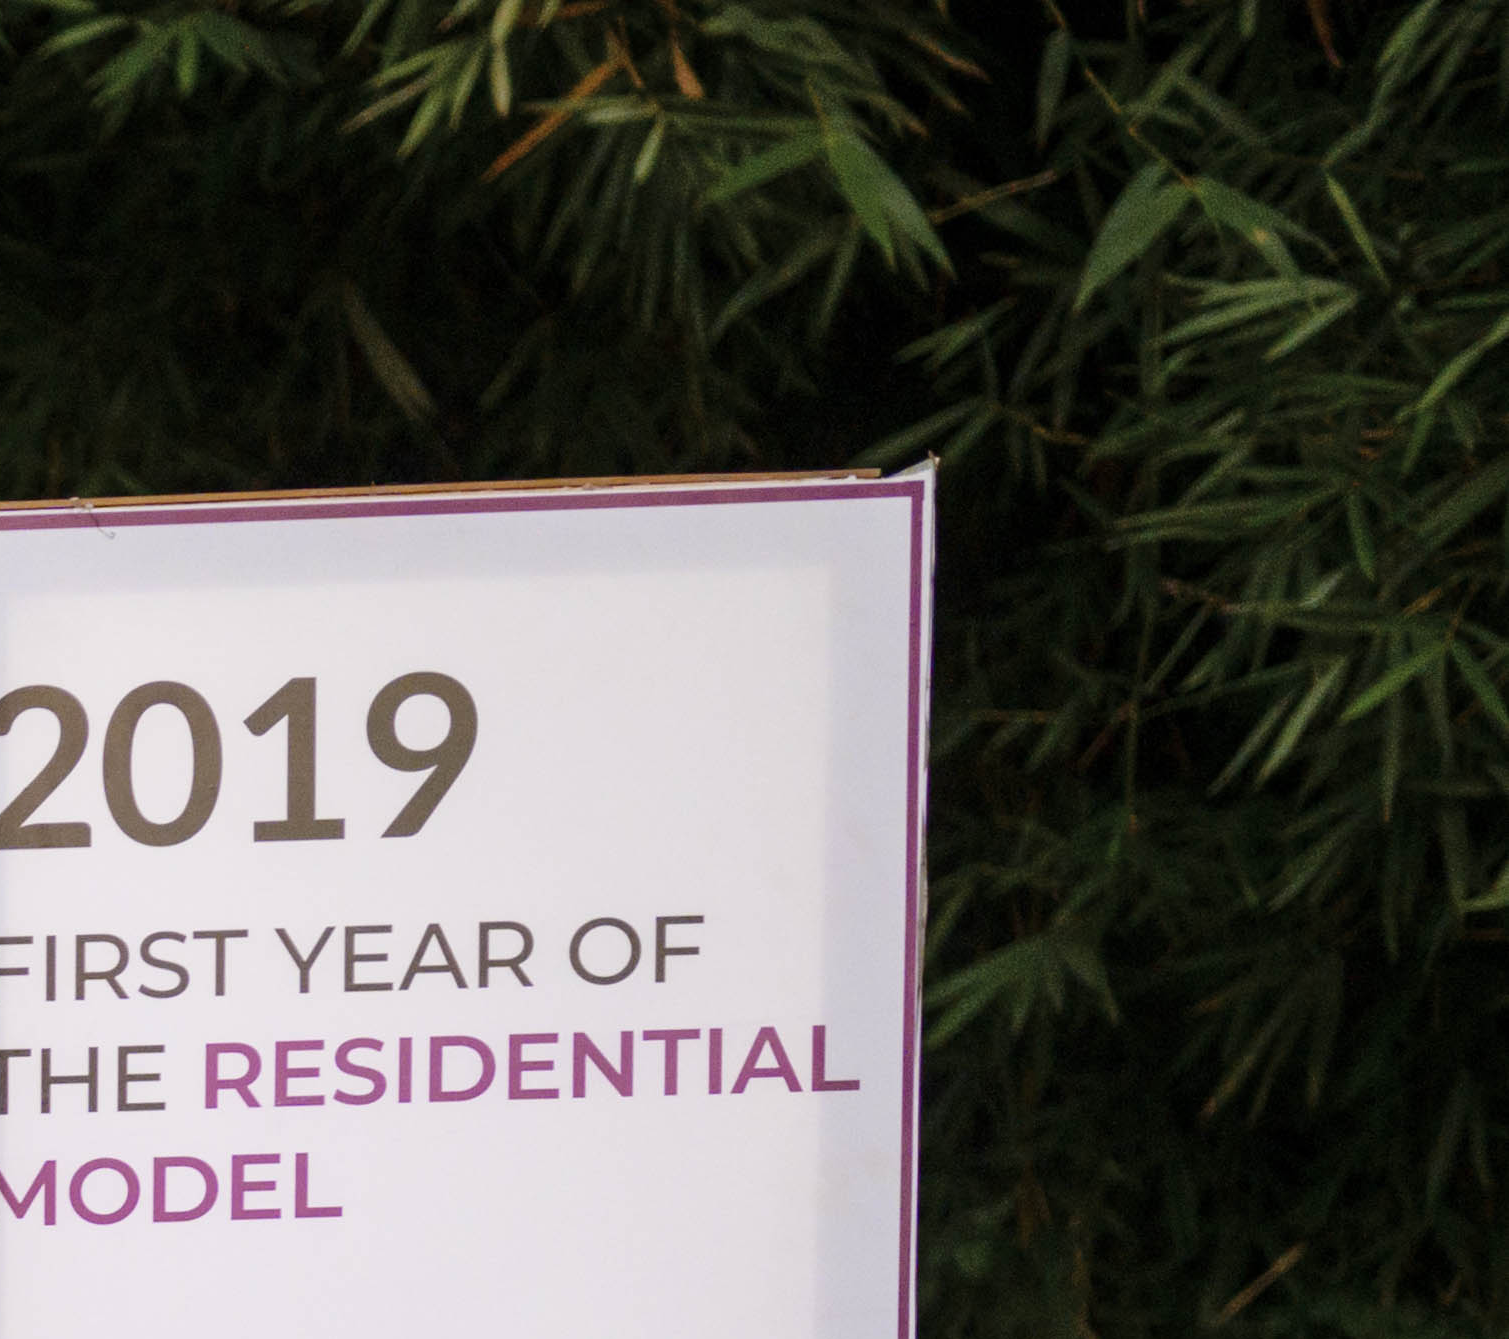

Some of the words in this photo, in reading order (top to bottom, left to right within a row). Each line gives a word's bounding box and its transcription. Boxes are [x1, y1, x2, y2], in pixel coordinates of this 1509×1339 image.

[276, 921, 534, 994] YEAR
[569, 915, 705, 986] OF
[205, 1023, 860, 1110] RESIDENTIAL
